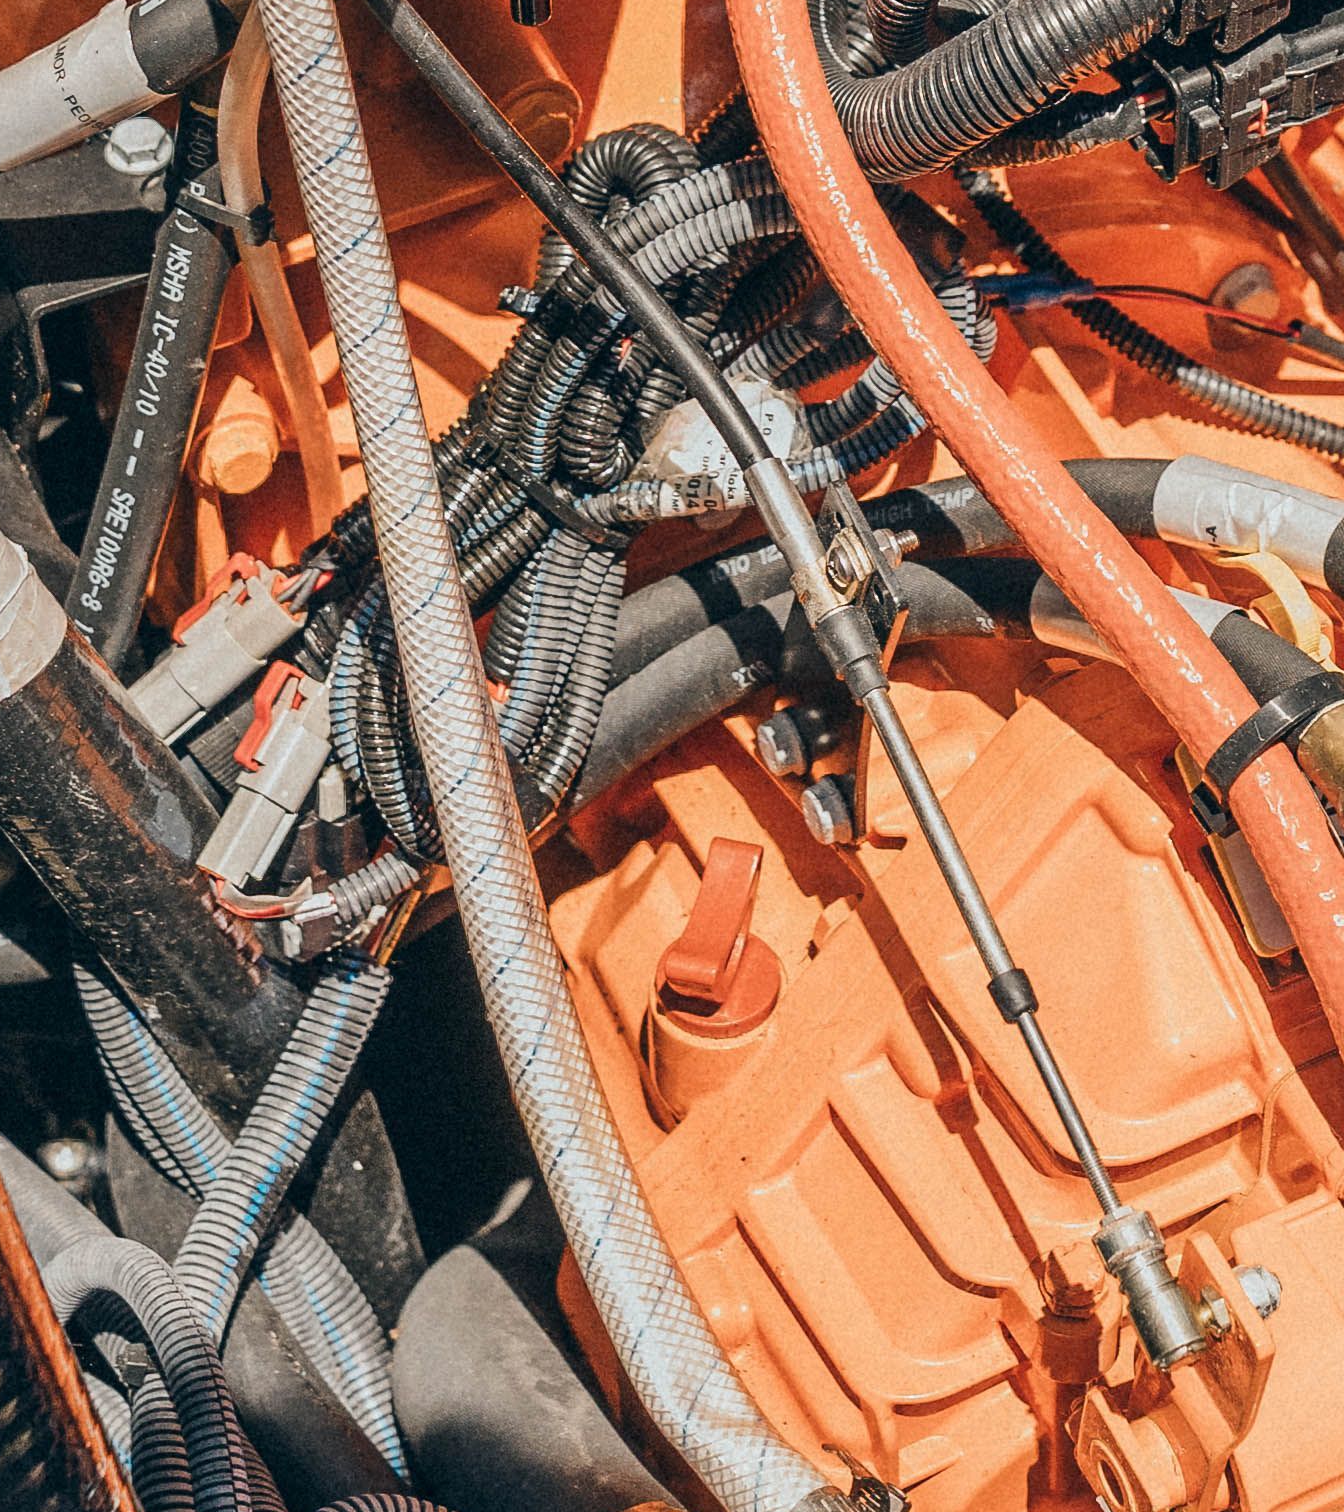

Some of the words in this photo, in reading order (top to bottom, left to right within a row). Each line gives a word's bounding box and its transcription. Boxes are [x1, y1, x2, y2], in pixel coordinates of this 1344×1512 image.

[161, 242, 193, 303] MSHA
[135, 310, 180, 417] IC-40/10
[926, 487, 974, 513] TEMP
[80, 487, 136, 613] SAE100R6-8
